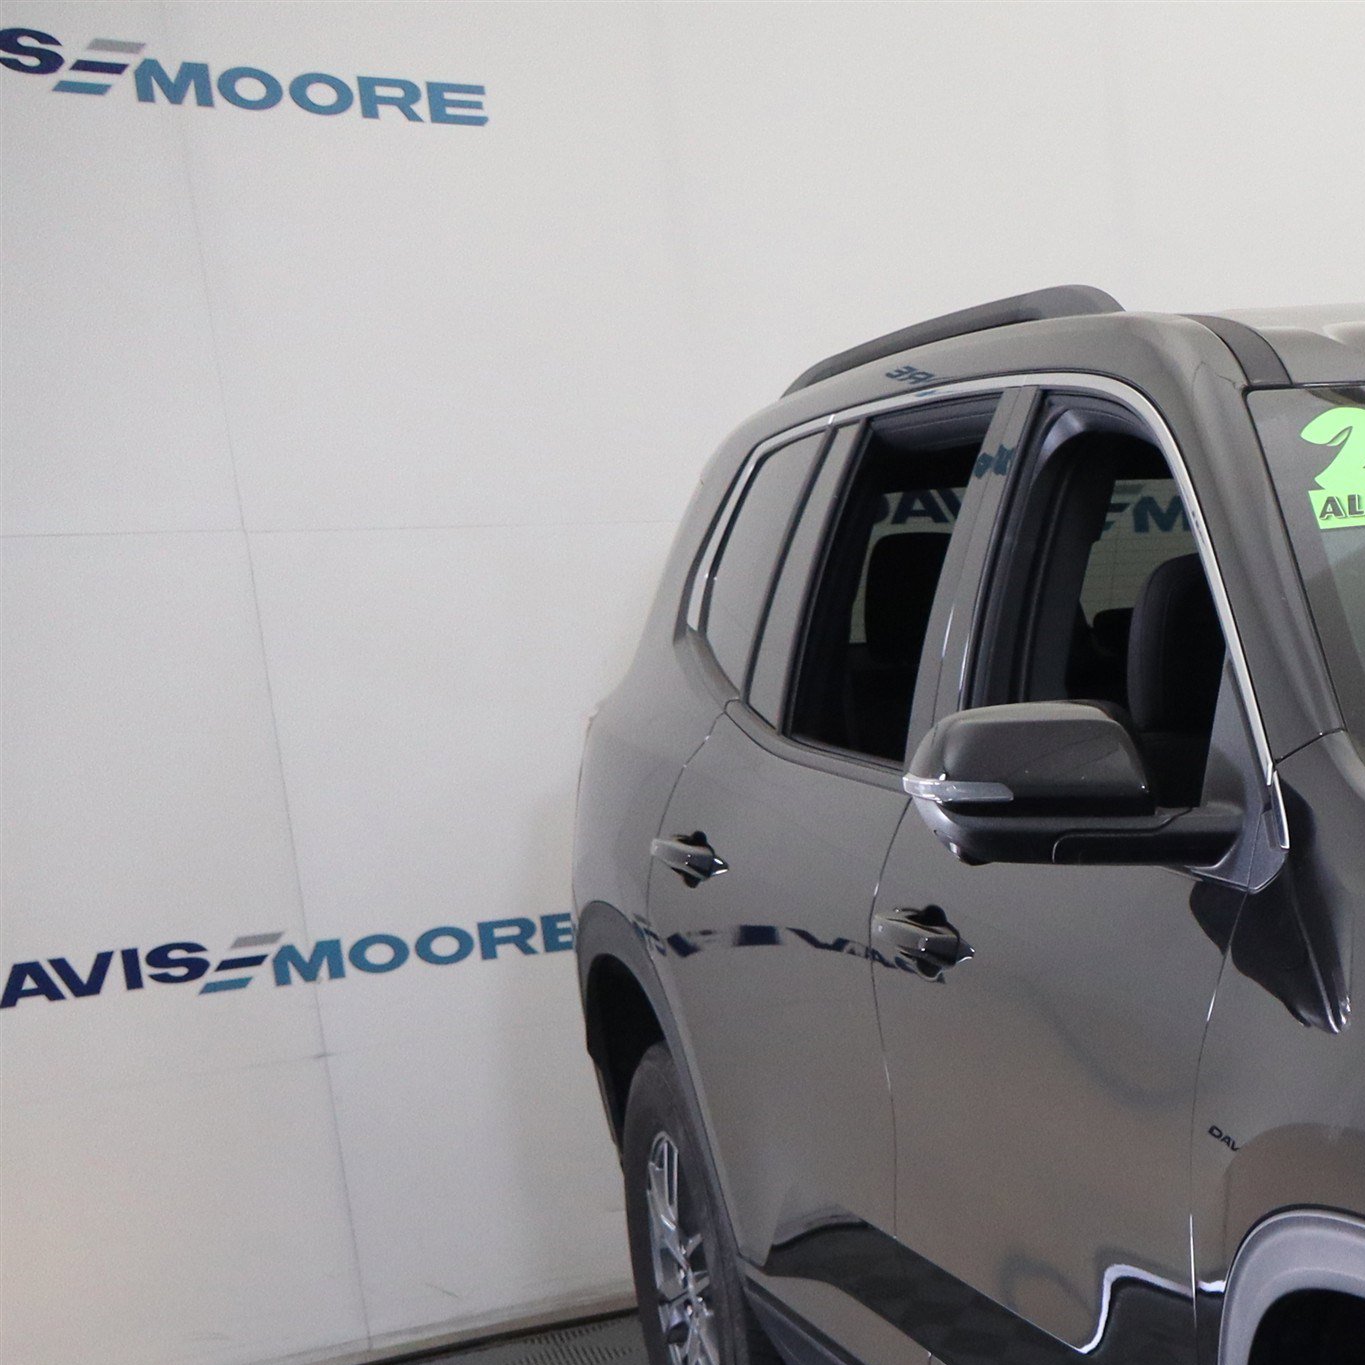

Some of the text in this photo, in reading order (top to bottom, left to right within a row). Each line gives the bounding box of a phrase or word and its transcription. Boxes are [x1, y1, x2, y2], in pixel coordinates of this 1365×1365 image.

[133, 57, 489, 126] MOORE
[0, 941, 211, 1009] AVIS
[273, 912, 573, 987] MOORE
